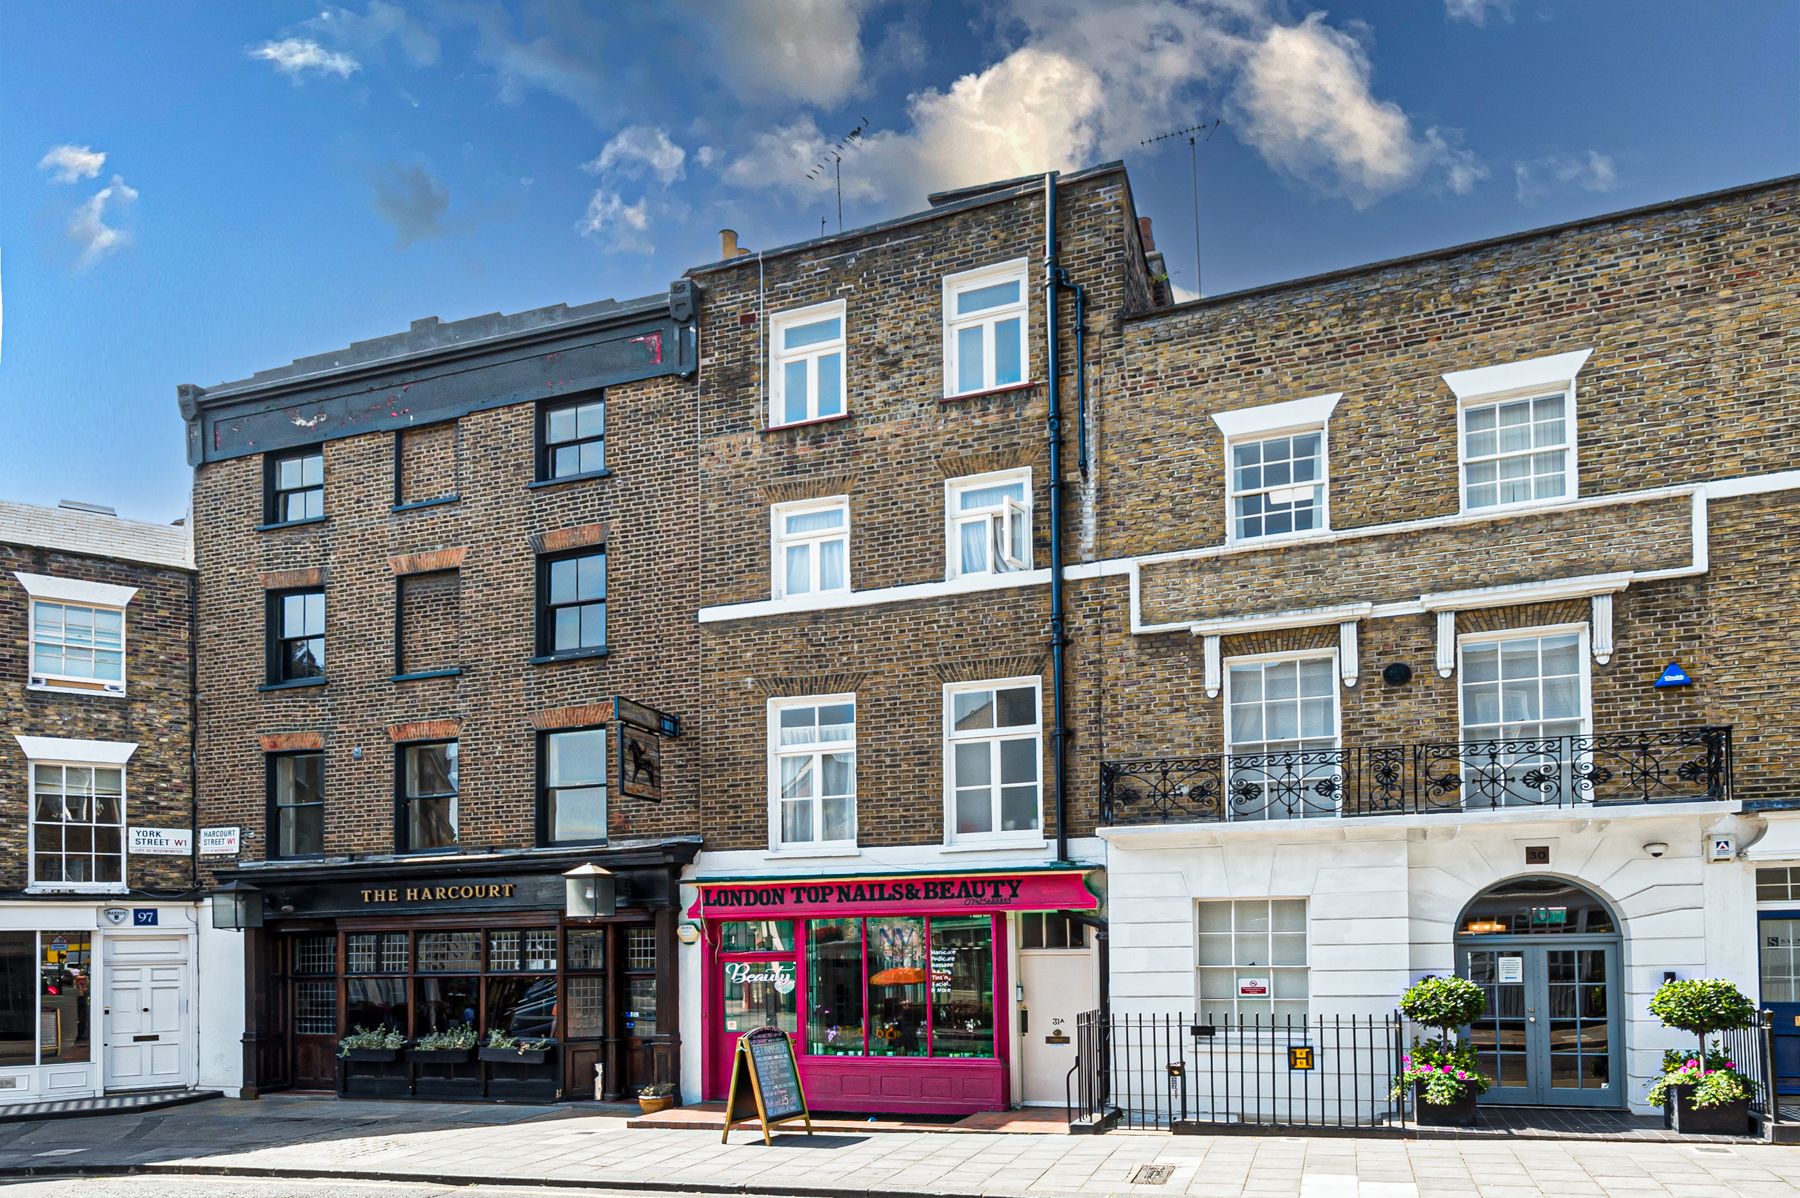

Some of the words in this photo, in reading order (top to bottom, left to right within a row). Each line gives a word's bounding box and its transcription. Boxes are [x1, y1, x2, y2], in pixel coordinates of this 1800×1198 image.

[135, 830, 162, 838] YORK
[203, 829, 236, 838] HARCOURT
[135, 838, 170, 846] STREET
[174, 839, 187, 847] W1
[203, 838, 225, 846] STREET
[226, 837, 236, 845] W1
[1529, 851, 1546, 860] 30
[361, 889, 398, 902] THE
[406, 883, 515, 901] HARCOURT
[703, 889, 785, 906] LONDON
[137, 911, 154, 923] 97
[725, 962, 796, 985] Beauty
[1052, 1017, 1065, 1025] 31A
